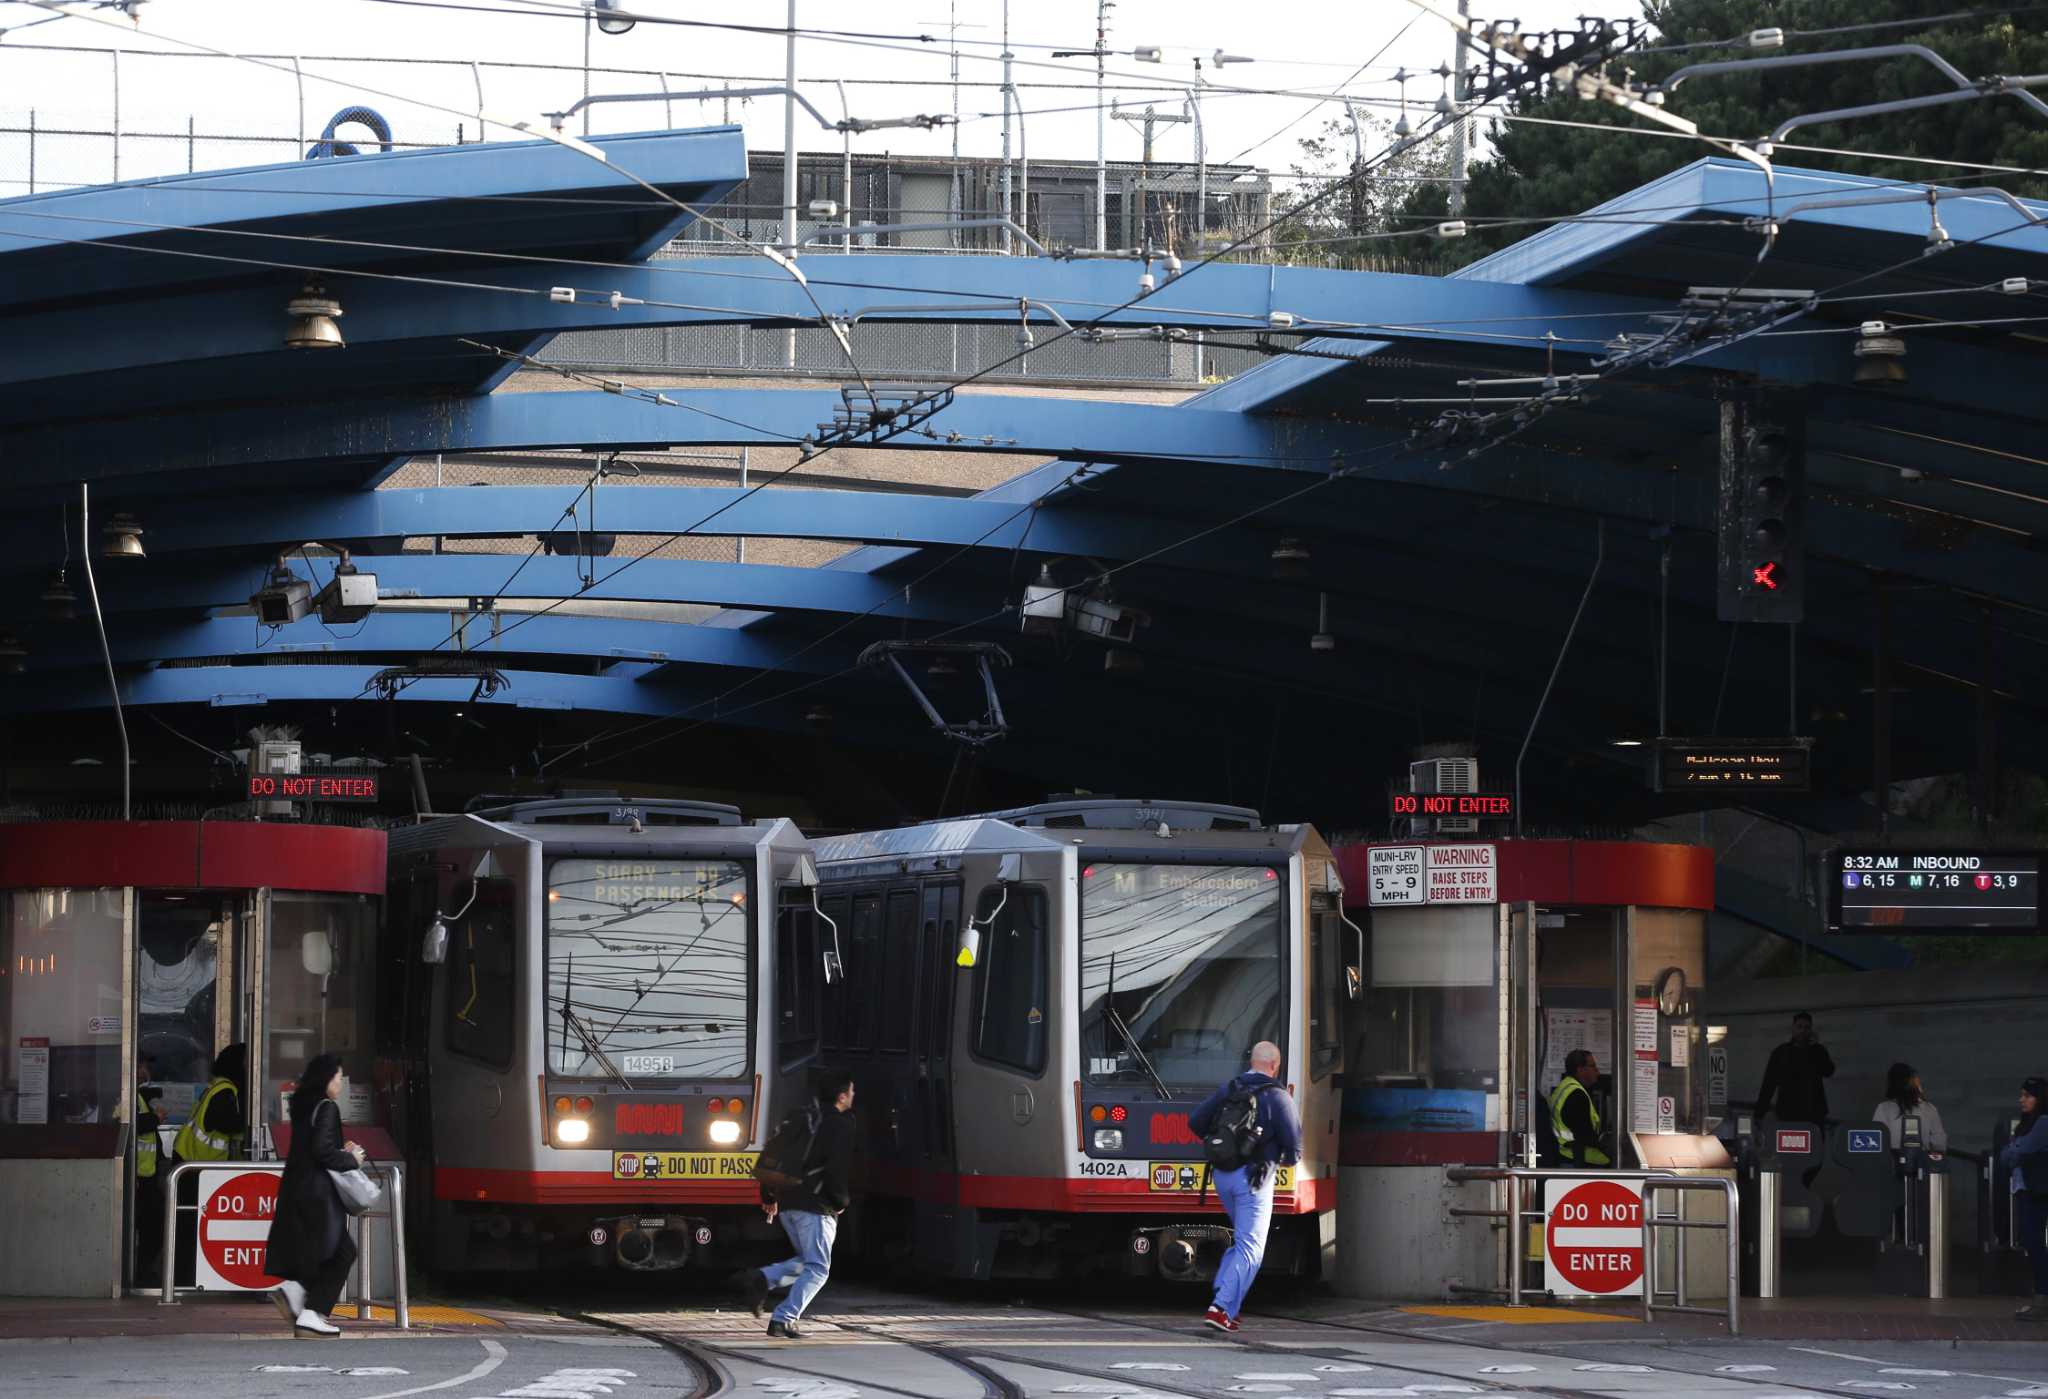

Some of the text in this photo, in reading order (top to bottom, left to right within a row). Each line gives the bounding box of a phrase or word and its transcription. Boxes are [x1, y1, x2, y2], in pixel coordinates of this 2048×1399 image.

[251, 778, 374, 796] DO NOT ENTER
[1394, 796, 1510, 814] DO NOT ENTER
[1374, 851, 1417, 862] MUNI-LRV
[1433, 848, 1490, 865] WARNING
[1844, 857, 1980, 870] 8:32 AM INBOUND
[1372, 864, 1419, 876] ENTRY SPEED
[1432, 871, 1488, 885] RAISE STEPS
[1114, 872, 1259, 893] M Embarcadero
[1375, 878, 1384, 890] 5
[1406, 877, 1416, 888] 9
[1863, 874, 1875, 888] 6,
[1880, 874, 1895, 887] 15
[1910, 875, 1922, 887] M
[1928, 874, 1940, 888] 7,
[1944, 874, 1960, 887] 16
[1978, 875, 1988, 887] T
[1993, 875, 2005, 889] 3,
[2009, 875, 2018, 887] 9
[1182, 892, 1238, 907] Station
[1382, 891, 1409, 901] MPH
[1430, 887, 1491, 900] BEFORE ENTRY
[1710, 1056, 1726, 1074] NO
[619, 1157, 753, 1175] STOP DO NOT PASS
[1079, 1162, 1127, 1176] 1402A
[1155, 1168, 1174, 1184] STOP
[217, 1195, 244, 1214] DO
[1563, 1203, 1639, 1221] DO NOT
[224, 1248, 267, 1265] ENT
[1570, 1254, 1632, 1271] ENTER
